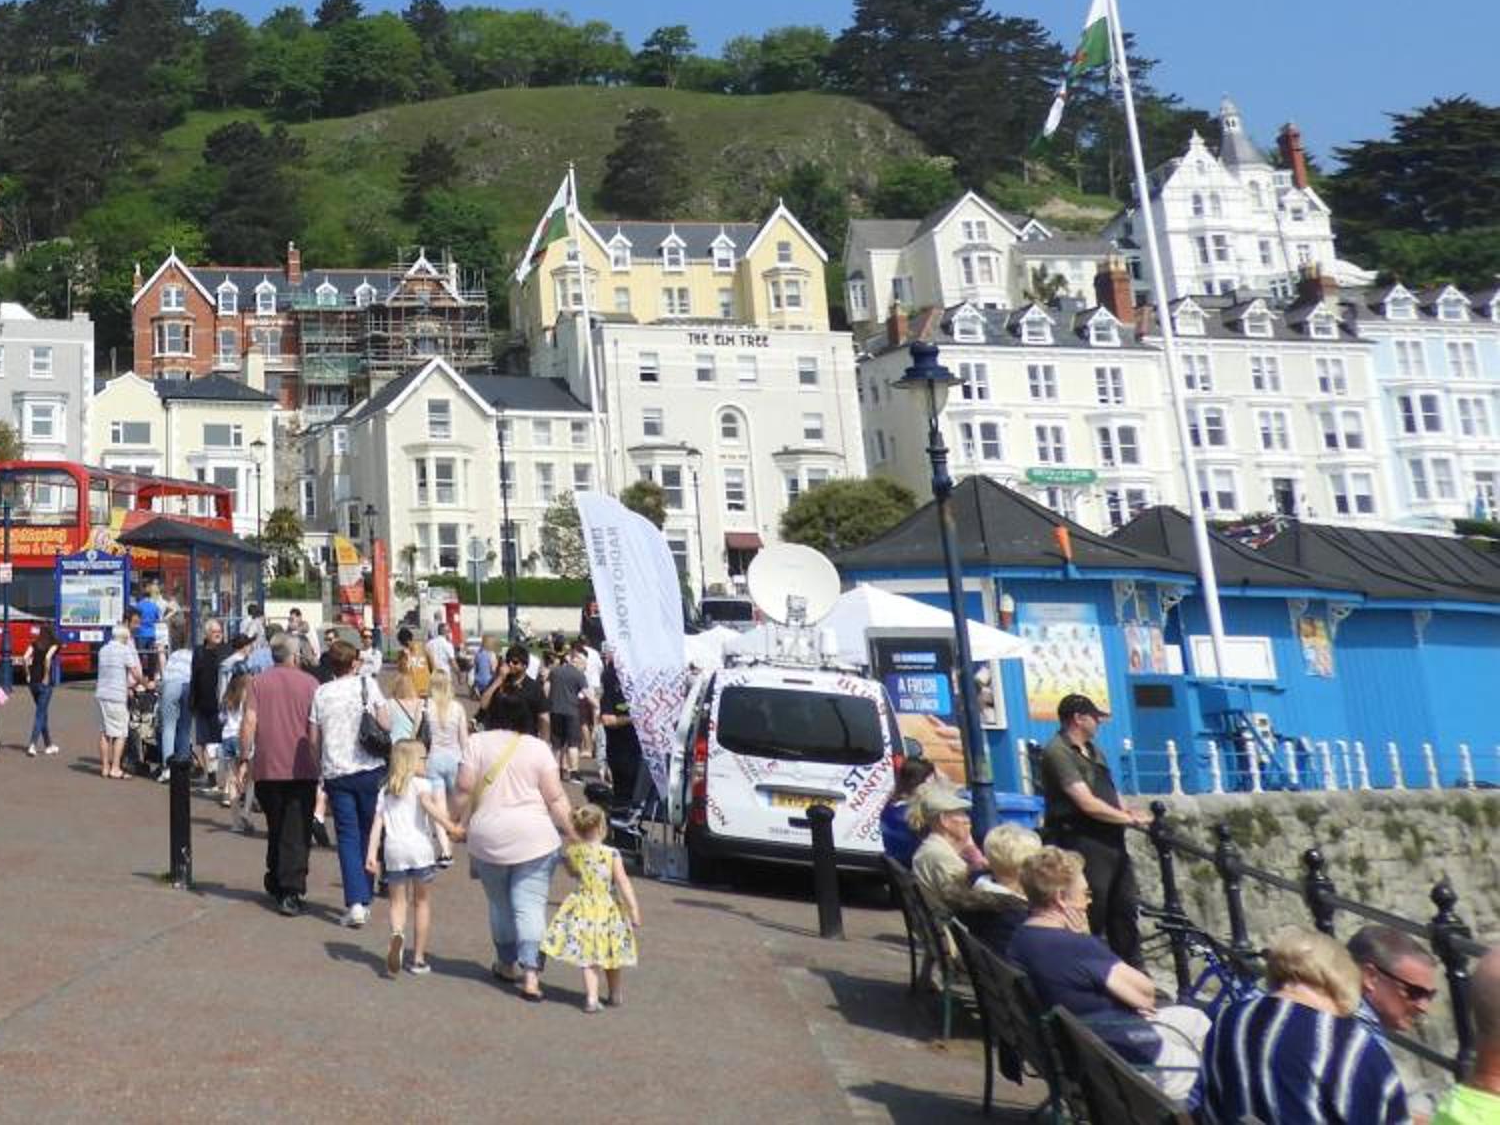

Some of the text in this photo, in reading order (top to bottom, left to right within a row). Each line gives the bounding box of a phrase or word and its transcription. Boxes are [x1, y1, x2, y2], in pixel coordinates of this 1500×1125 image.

[687, 332, 770, 348] THE ELM TREE
